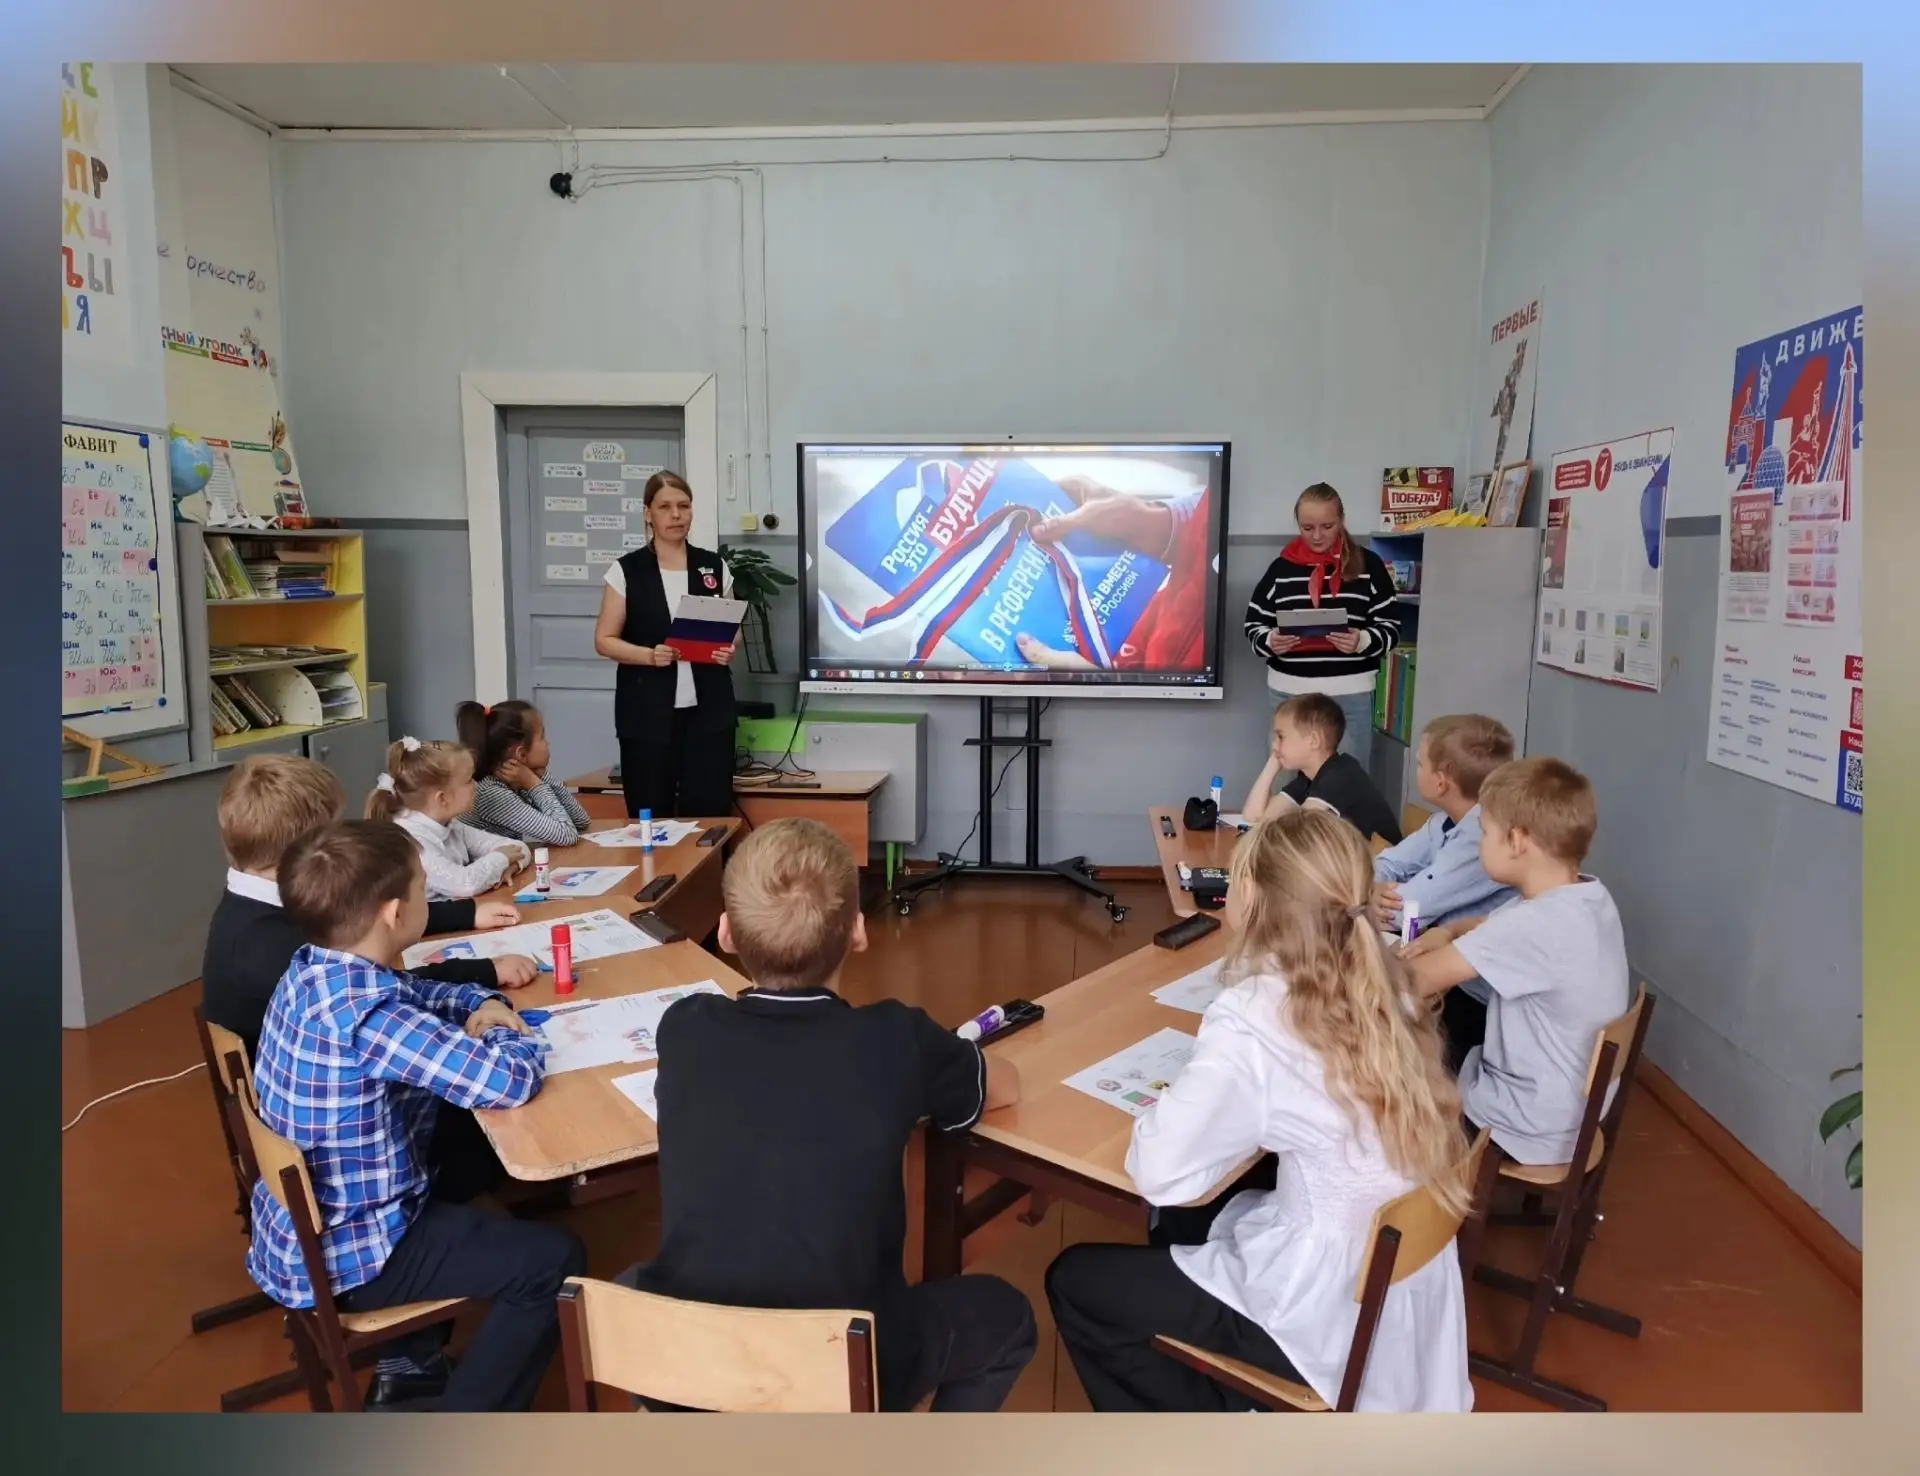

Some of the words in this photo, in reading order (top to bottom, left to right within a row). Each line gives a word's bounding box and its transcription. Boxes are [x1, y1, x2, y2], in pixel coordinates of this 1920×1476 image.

[1491, 300, 1538, 345] ПЕРВЫЕ
[198, 336, 242, 356] УГОЛОК
[1776, 314, 1863, 366] ДВИЖЕ
[64, 433, 117, 453] ФАВИТ
[1392, 491, 1440, 505] ПОБЕДА!
[881, 512, 930, 574] РОССИЯ
[904, 543, 929, 572] ЭТО
[1098, 550, 1136, 601] ВМЕСТЕ
[980, 628, 1006, 653] В
